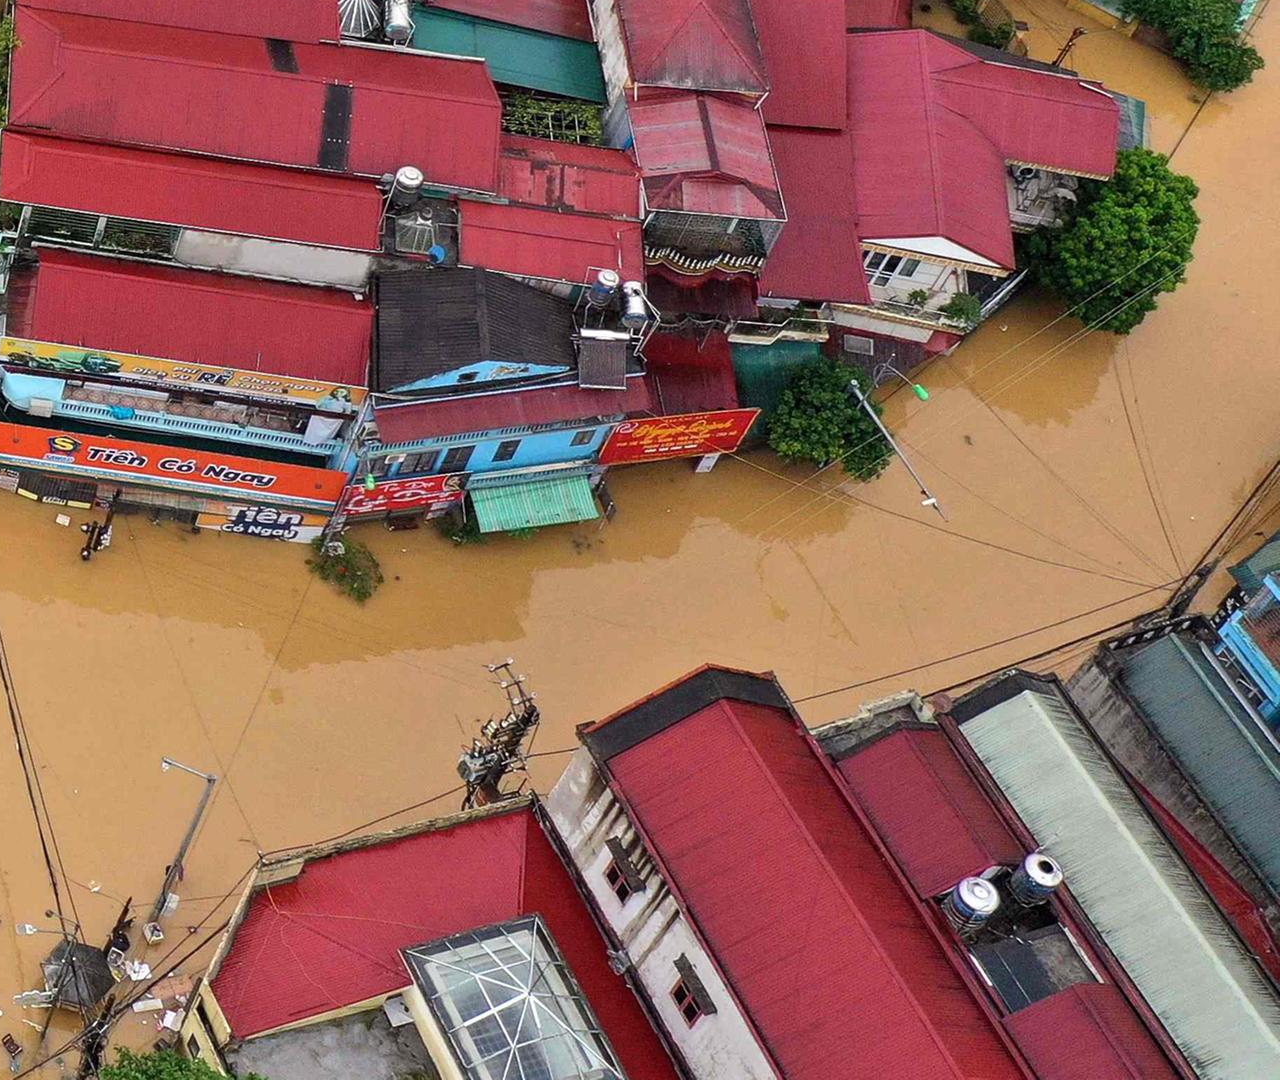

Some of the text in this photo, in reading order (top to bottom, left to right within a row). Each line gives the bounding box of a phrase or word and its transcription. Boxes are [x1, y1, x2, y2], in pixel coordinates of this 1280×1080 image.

[88, 447, 147, 467] Tiền
[158, 457, 195, 474] Có
[203, 464, 277, 488] Ngay
[222, 524, 245, 533] Có
[248, 526, 297, 540] Ngay
